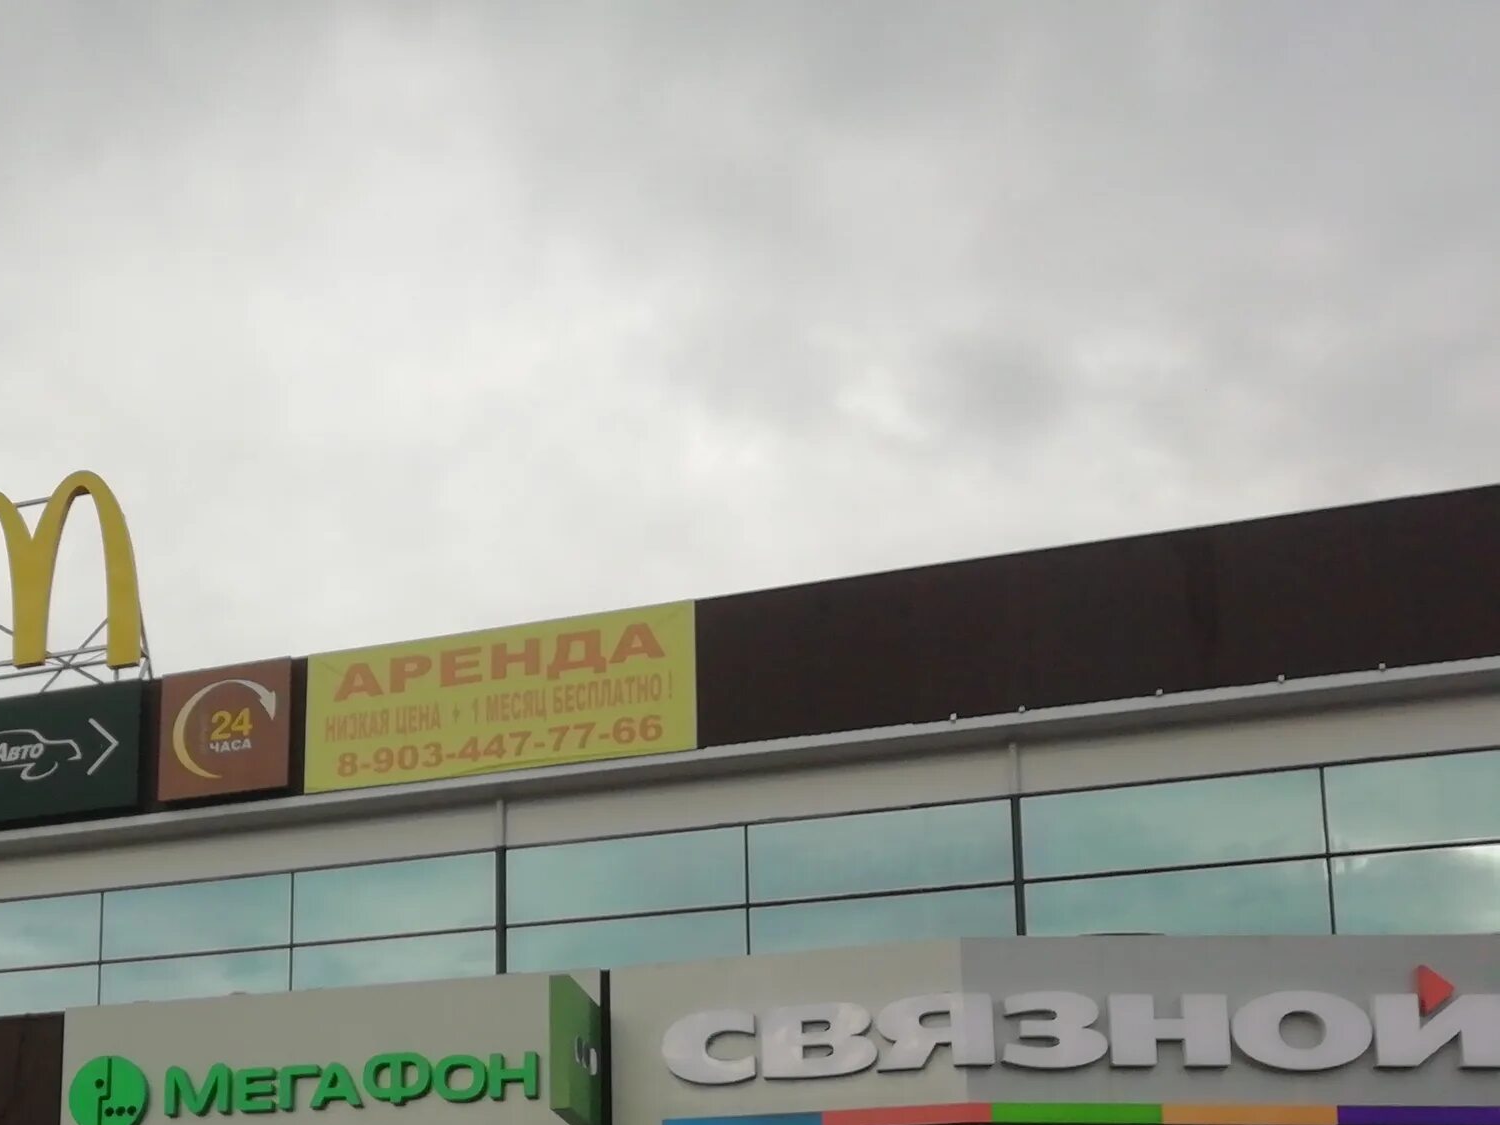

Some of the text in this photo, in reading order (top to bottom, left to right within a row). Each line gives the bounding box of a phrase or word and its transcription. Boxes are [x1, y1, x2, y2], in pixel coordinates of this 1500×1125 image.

[333, 622, 666, 702] АРЕНДА
[210, 707, 253, 740] 24
[324, 708, 390, 742] НИЗКАЯ
[394, 704, 441, 737] ЦЕНА
[471, 698, 481, 723] 1
[485, 689, 548, 723] МЕСЯЦ
[552, 674, 663, 714] БЕСПЛАТНО
[209, 738, 252, 753] ЧАСА
[336, 715, 664, 777] 8-903-447-77-66
[661, 965, 1500, 1084] СВЯЗНОЙ
